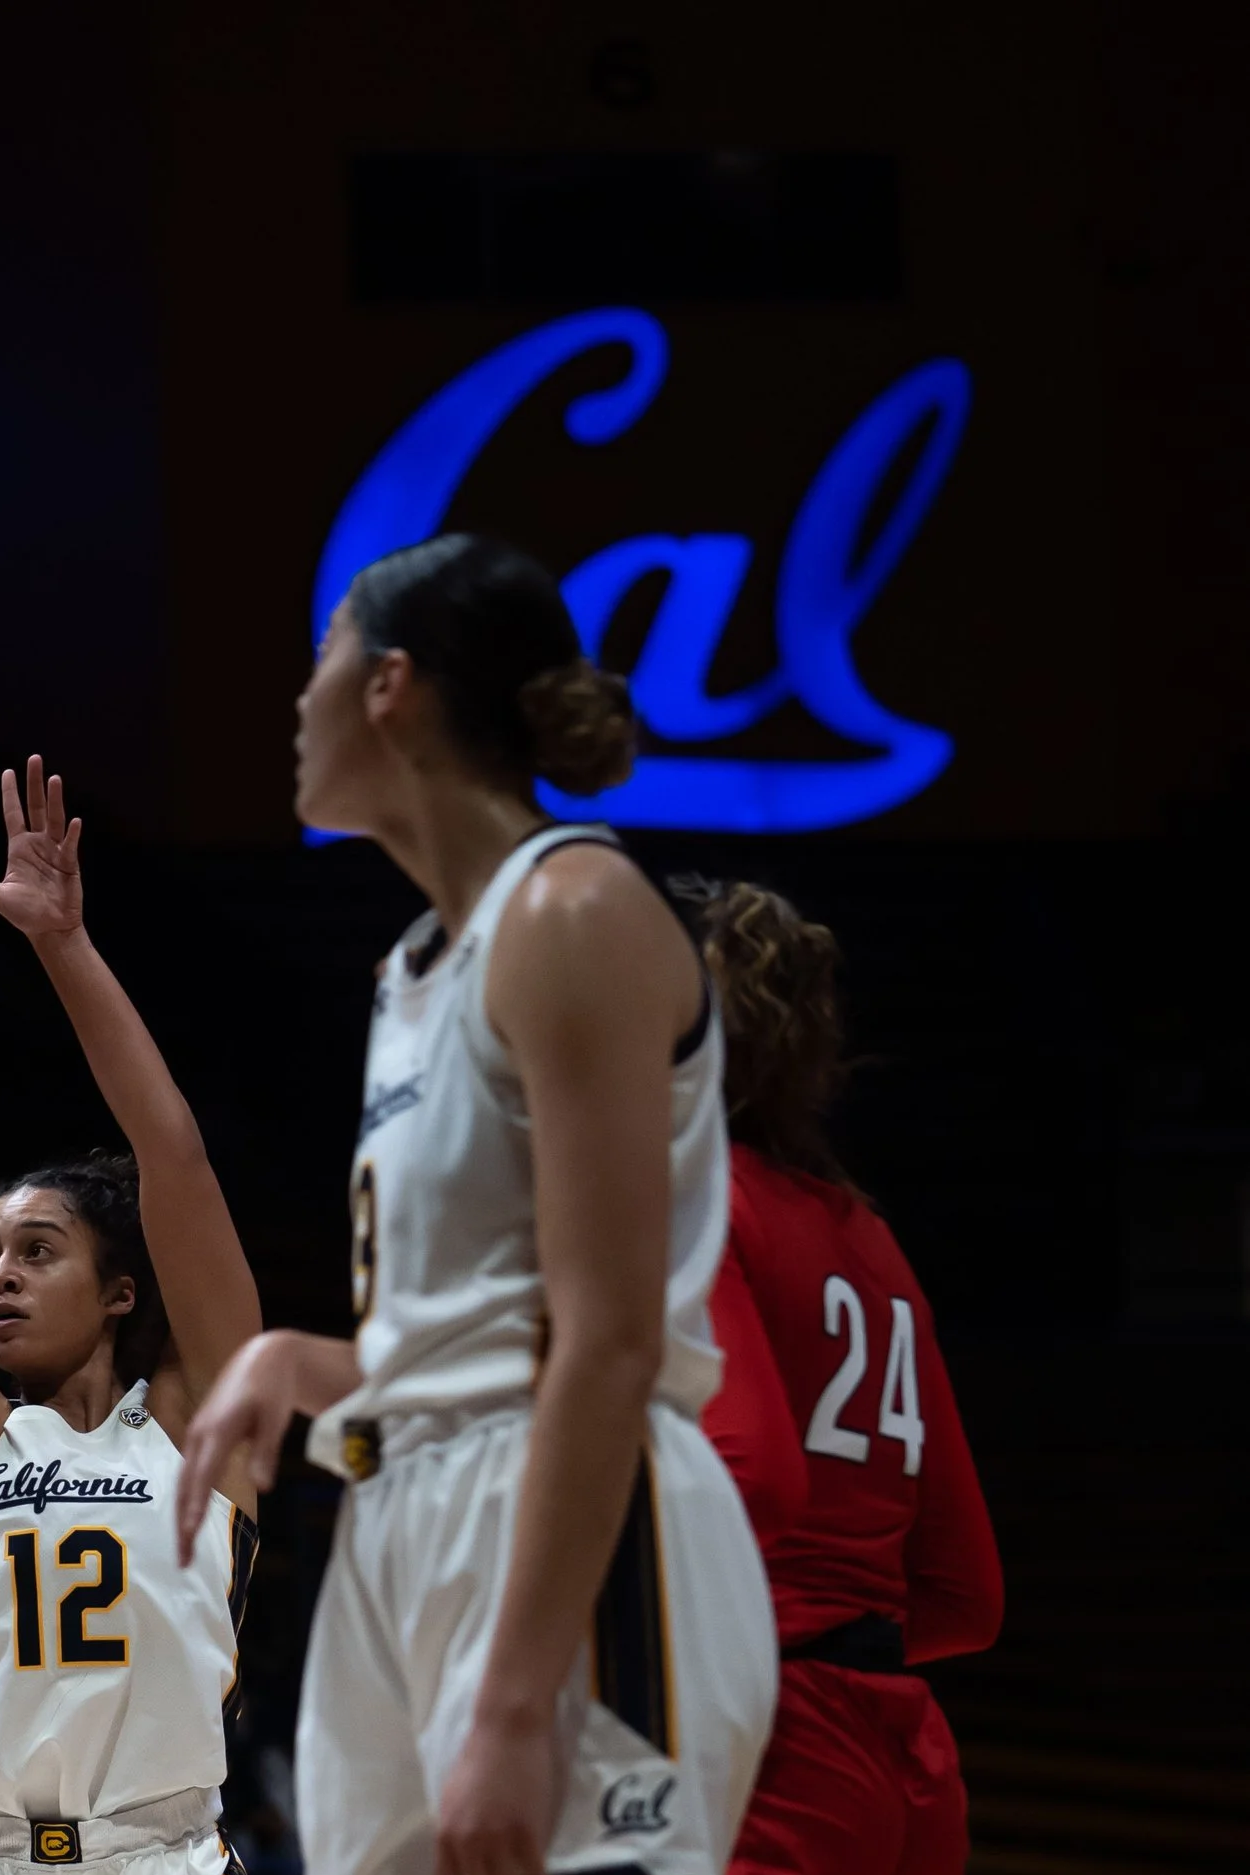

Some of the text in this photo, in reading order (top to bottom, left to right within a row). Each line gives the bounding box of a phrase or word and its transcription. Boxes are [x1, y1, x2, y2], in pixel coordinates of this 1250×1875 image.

[310, 303, 976, 848] Cal
[804, 1274, 925, 1477] 24
[4, 1525, 130, 1671] 12
[600, 1773, 677, 1839] Cal
